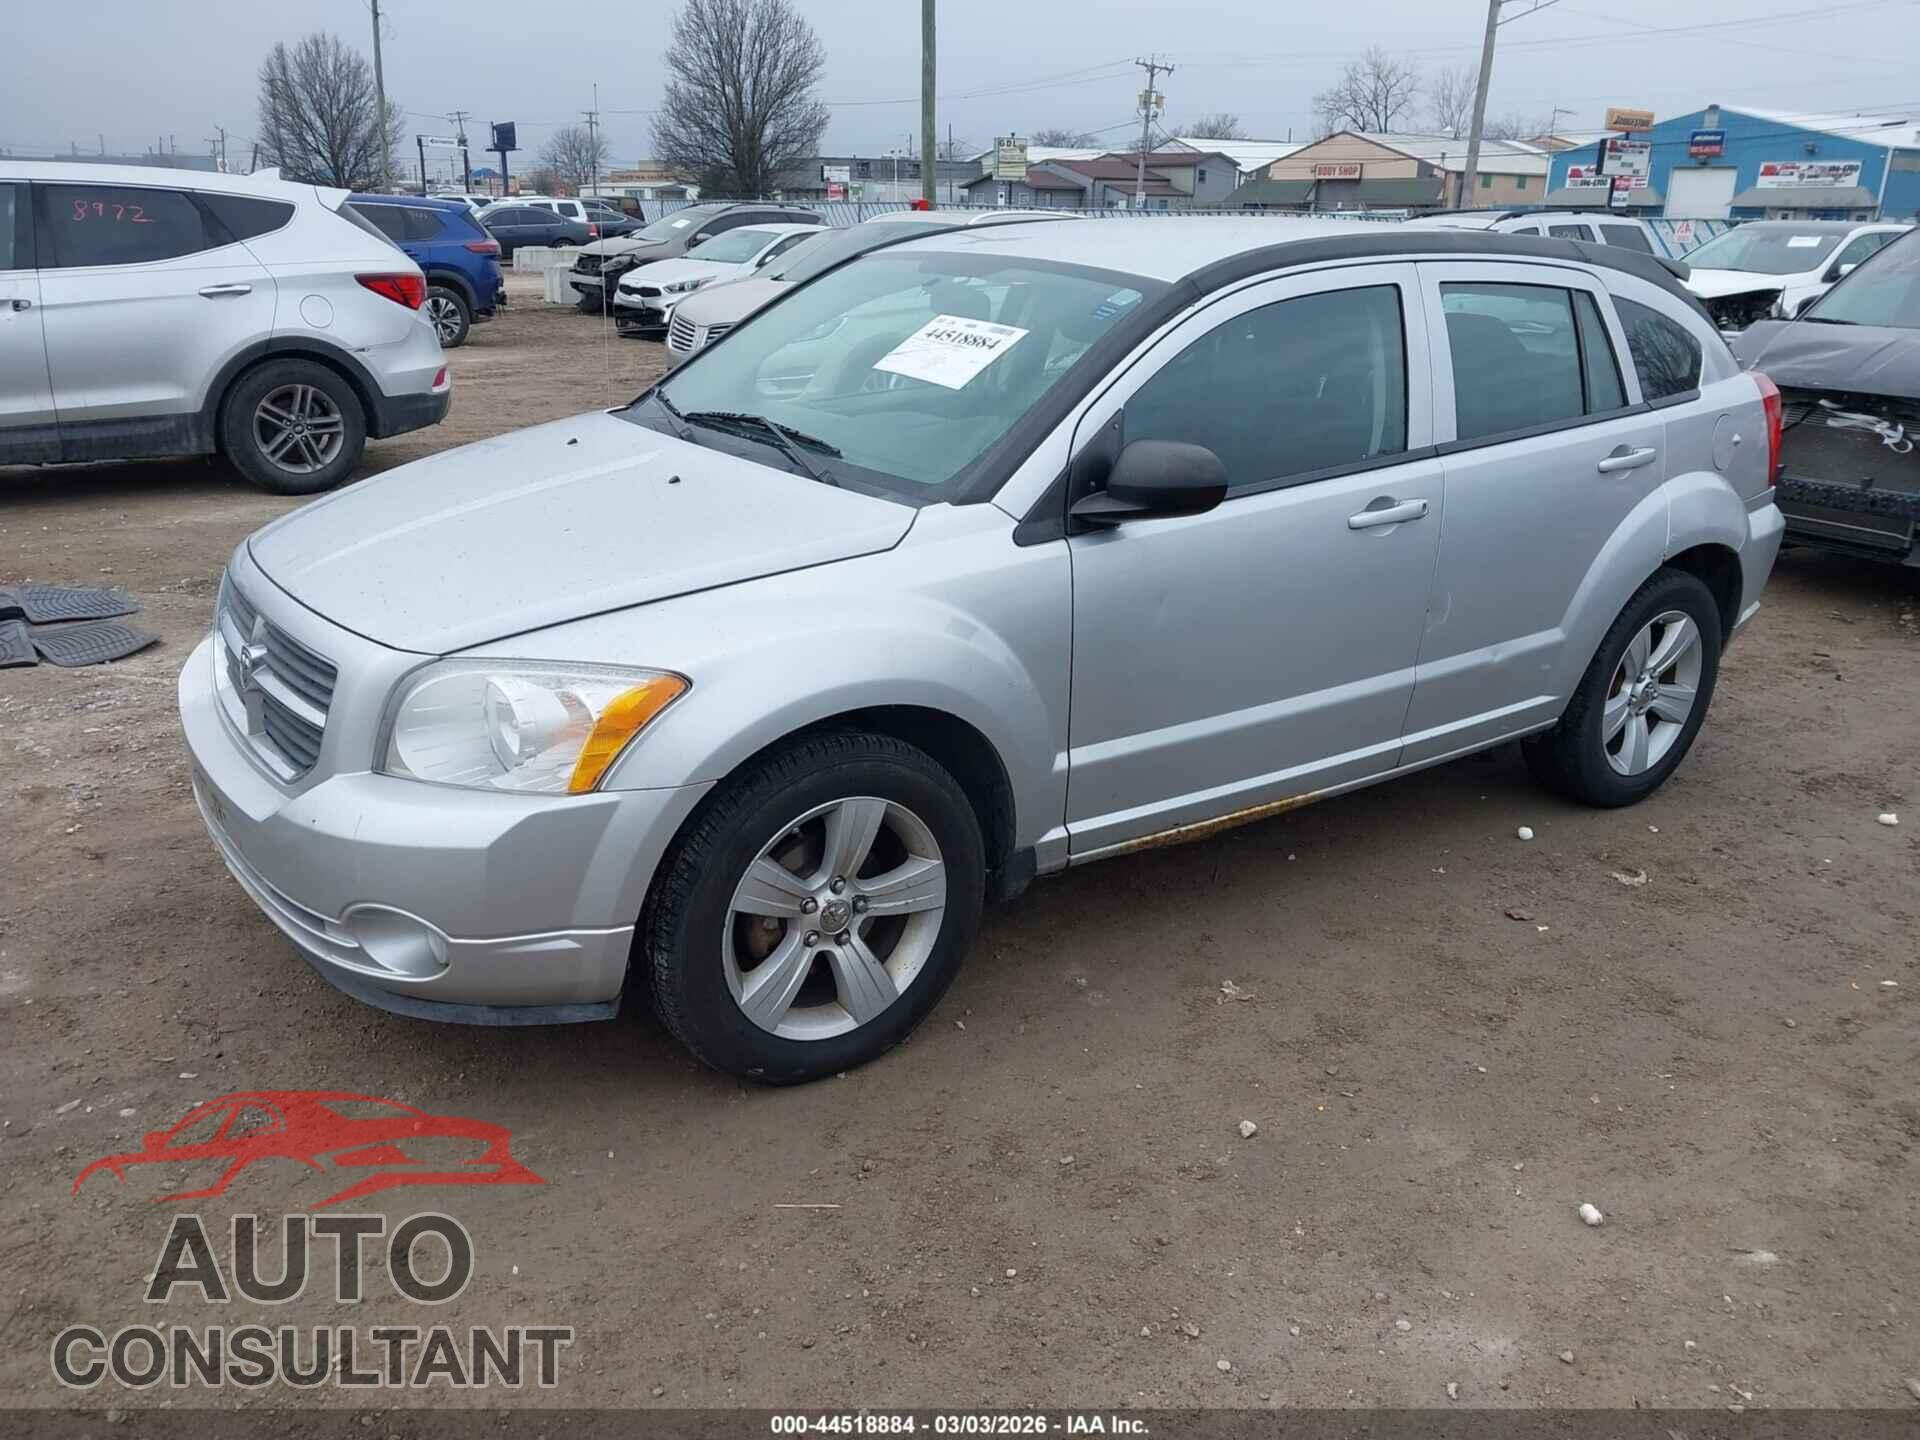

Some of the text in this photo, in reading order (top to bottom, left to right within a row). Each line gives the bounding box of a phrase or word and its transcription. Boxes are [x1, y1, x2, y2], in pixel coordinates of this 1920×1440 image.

[1317, 166, 1359, 176] BODY SHOP
[73, 199, 155, 223] 8972
[925, 327, 1001, 350] 44518884
